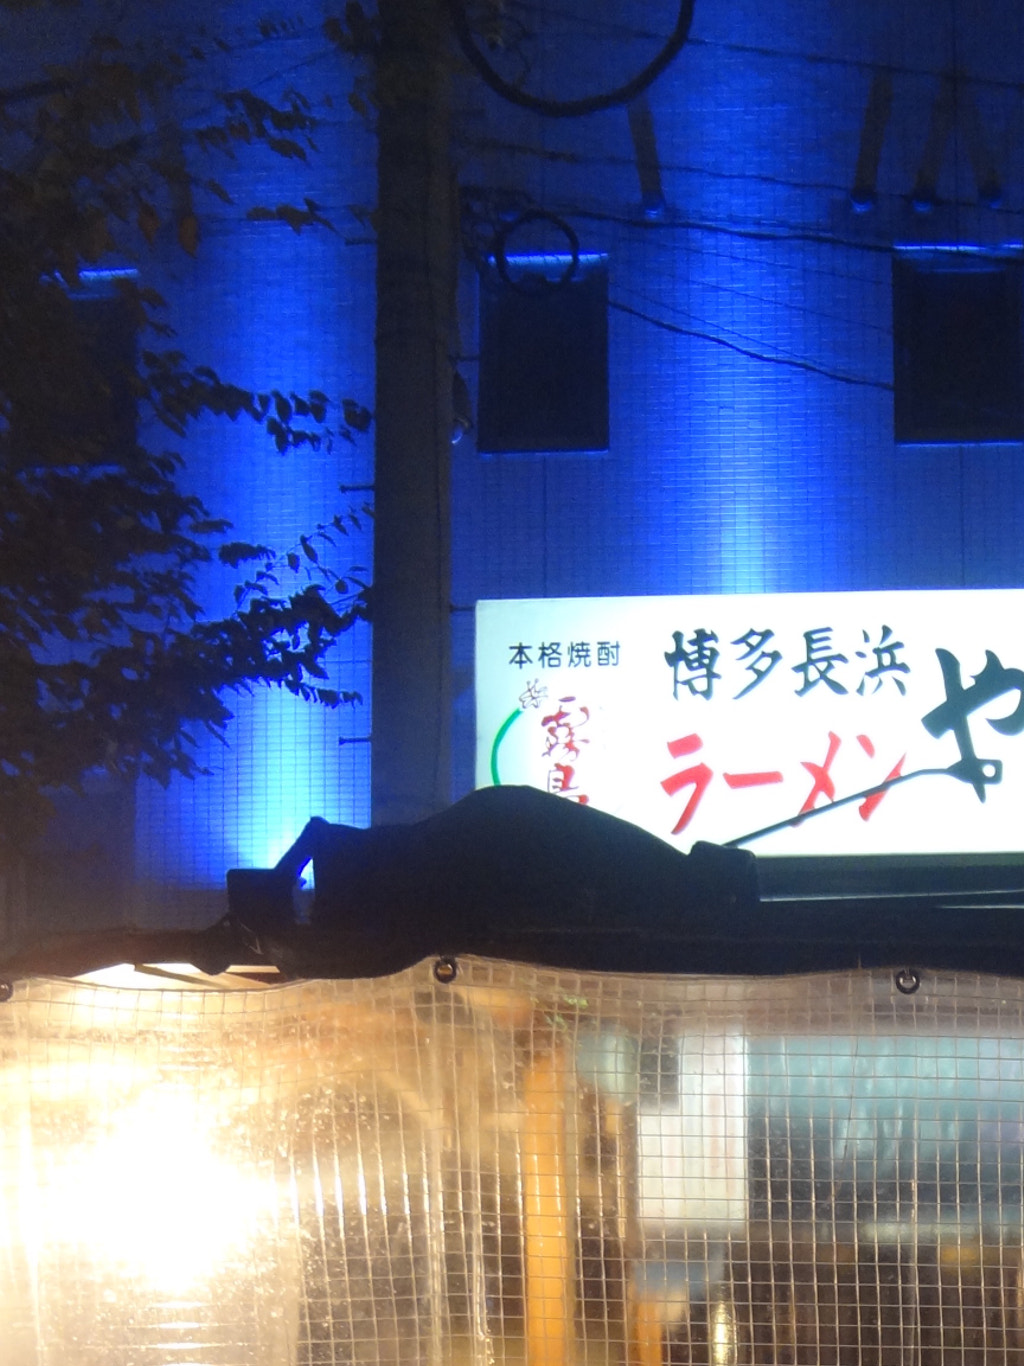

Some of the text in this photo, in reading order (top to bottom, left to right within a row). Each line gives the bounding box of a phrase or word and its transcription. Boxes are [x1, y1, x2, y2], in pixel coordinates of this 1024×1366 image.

[508, 640, 620, 670] 本格焼酎
[664, 625, 910, 700] 博多長浜
[660, 731, 905, 835] ラーメン
